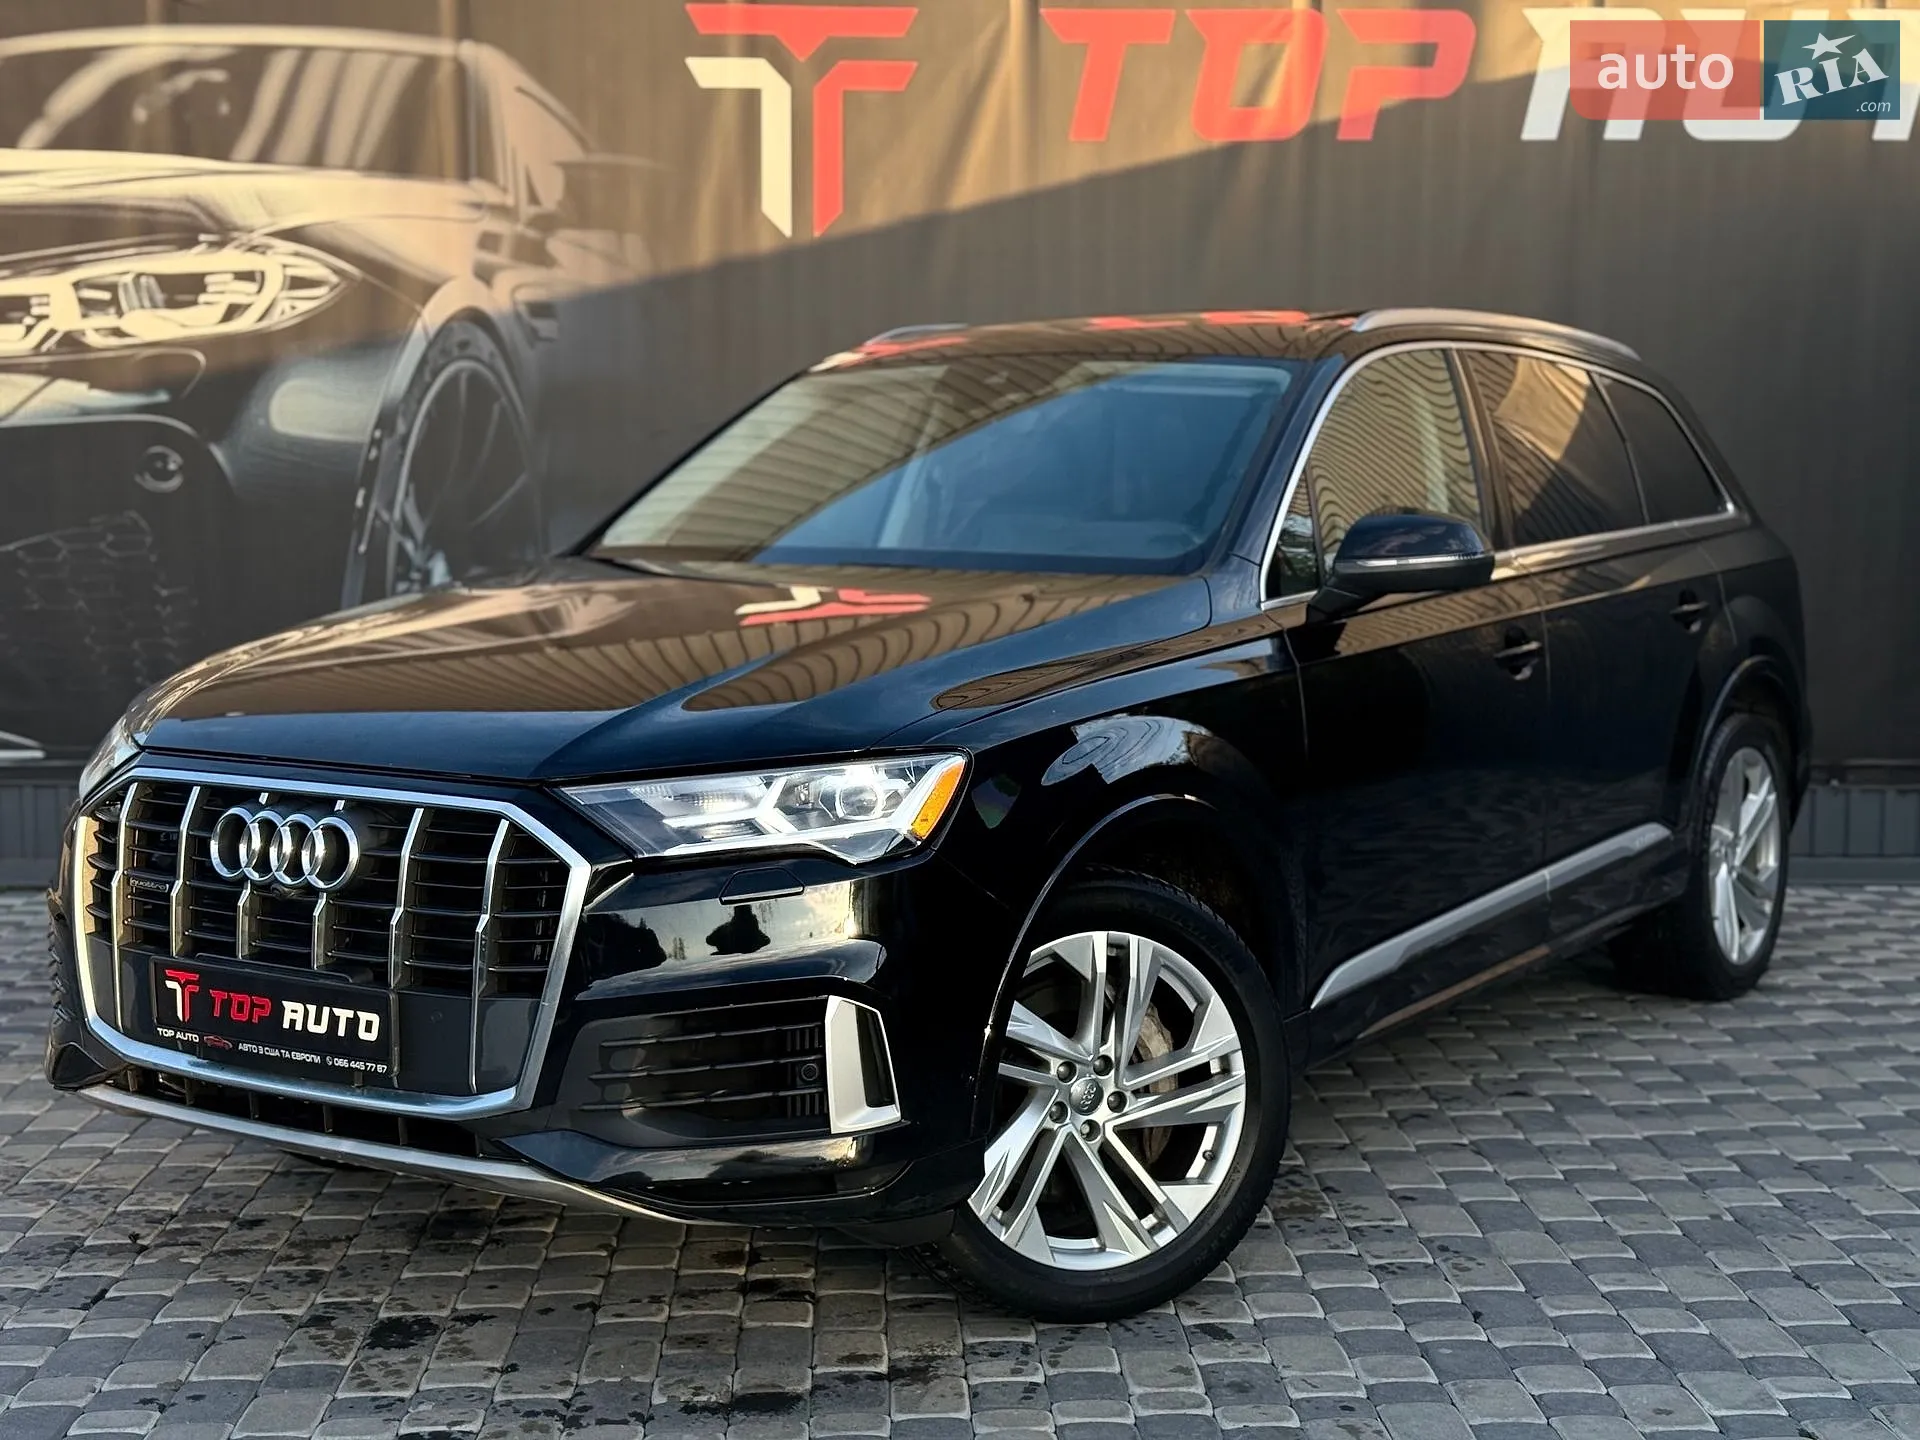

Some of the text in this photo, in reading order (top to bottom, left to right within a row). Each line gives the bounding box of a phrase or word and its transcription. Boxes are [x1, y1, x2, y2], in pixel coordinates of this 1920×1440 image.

[1040, 8, 1476, 142] TOP
[209, 988, 381, 1042] TOP AUTO
[157, 1027, 199, 1042] TOP AUTO
[238, 1043, 257, 1053] АВТО
[264, 1047, 280, 1056] США
[280, 1049, 290, 1059] ТА
[291, 1051, 320, 1063] ЄВРОПИ
[333, 1057, 349, 1067] 066
[349, 1060, 366, 1071] 445
[365, 1062, 376, 1072] 77
